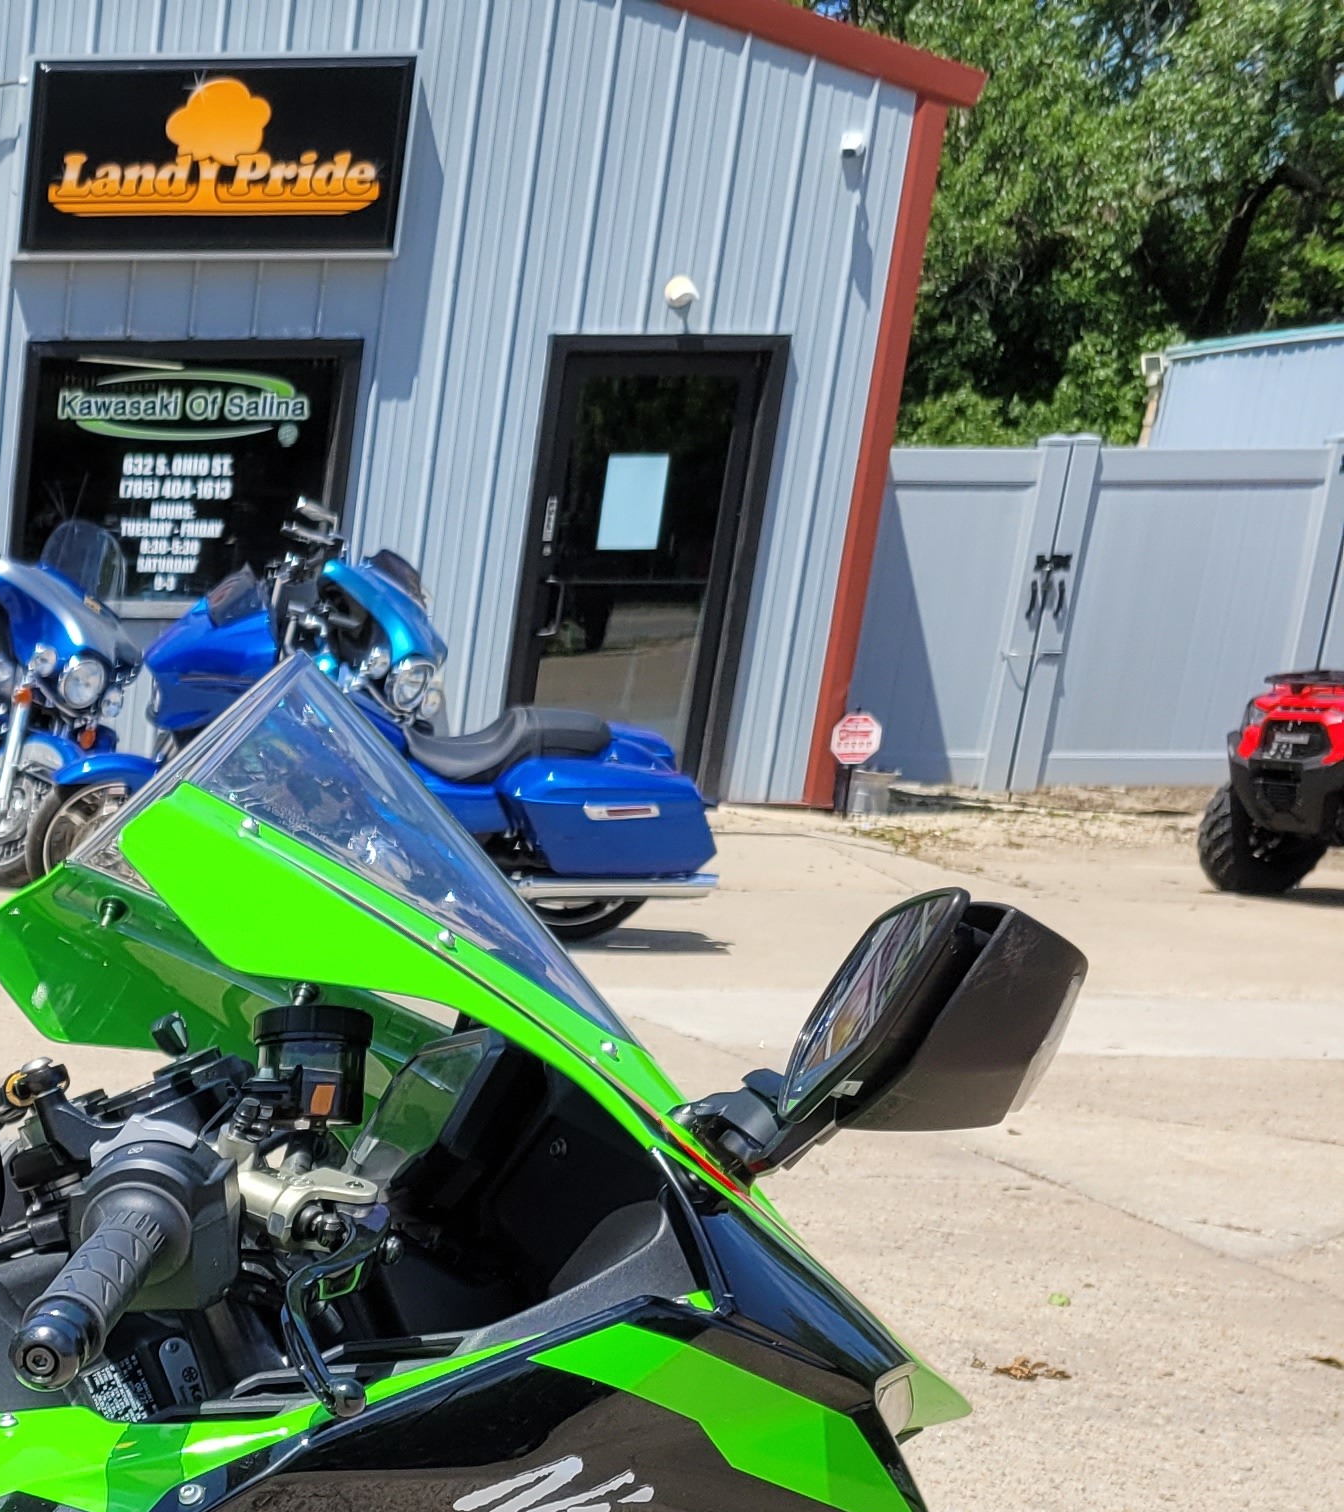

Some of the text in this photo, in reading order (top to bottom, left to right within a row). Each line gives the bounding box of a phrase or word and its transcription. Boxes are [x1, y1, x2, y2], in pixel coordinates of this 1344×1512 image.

[57, 152, 376, 197] Land Pride
[58, 389, 311, 420] Kawasaki Of Salina
[172, 453, 211, 476] OHIO
[121, 517, 173, 537] TUESDAY
[180, 519, 225, 538] FRIDAY
[136, 555, 199, 573] SATURDAY
